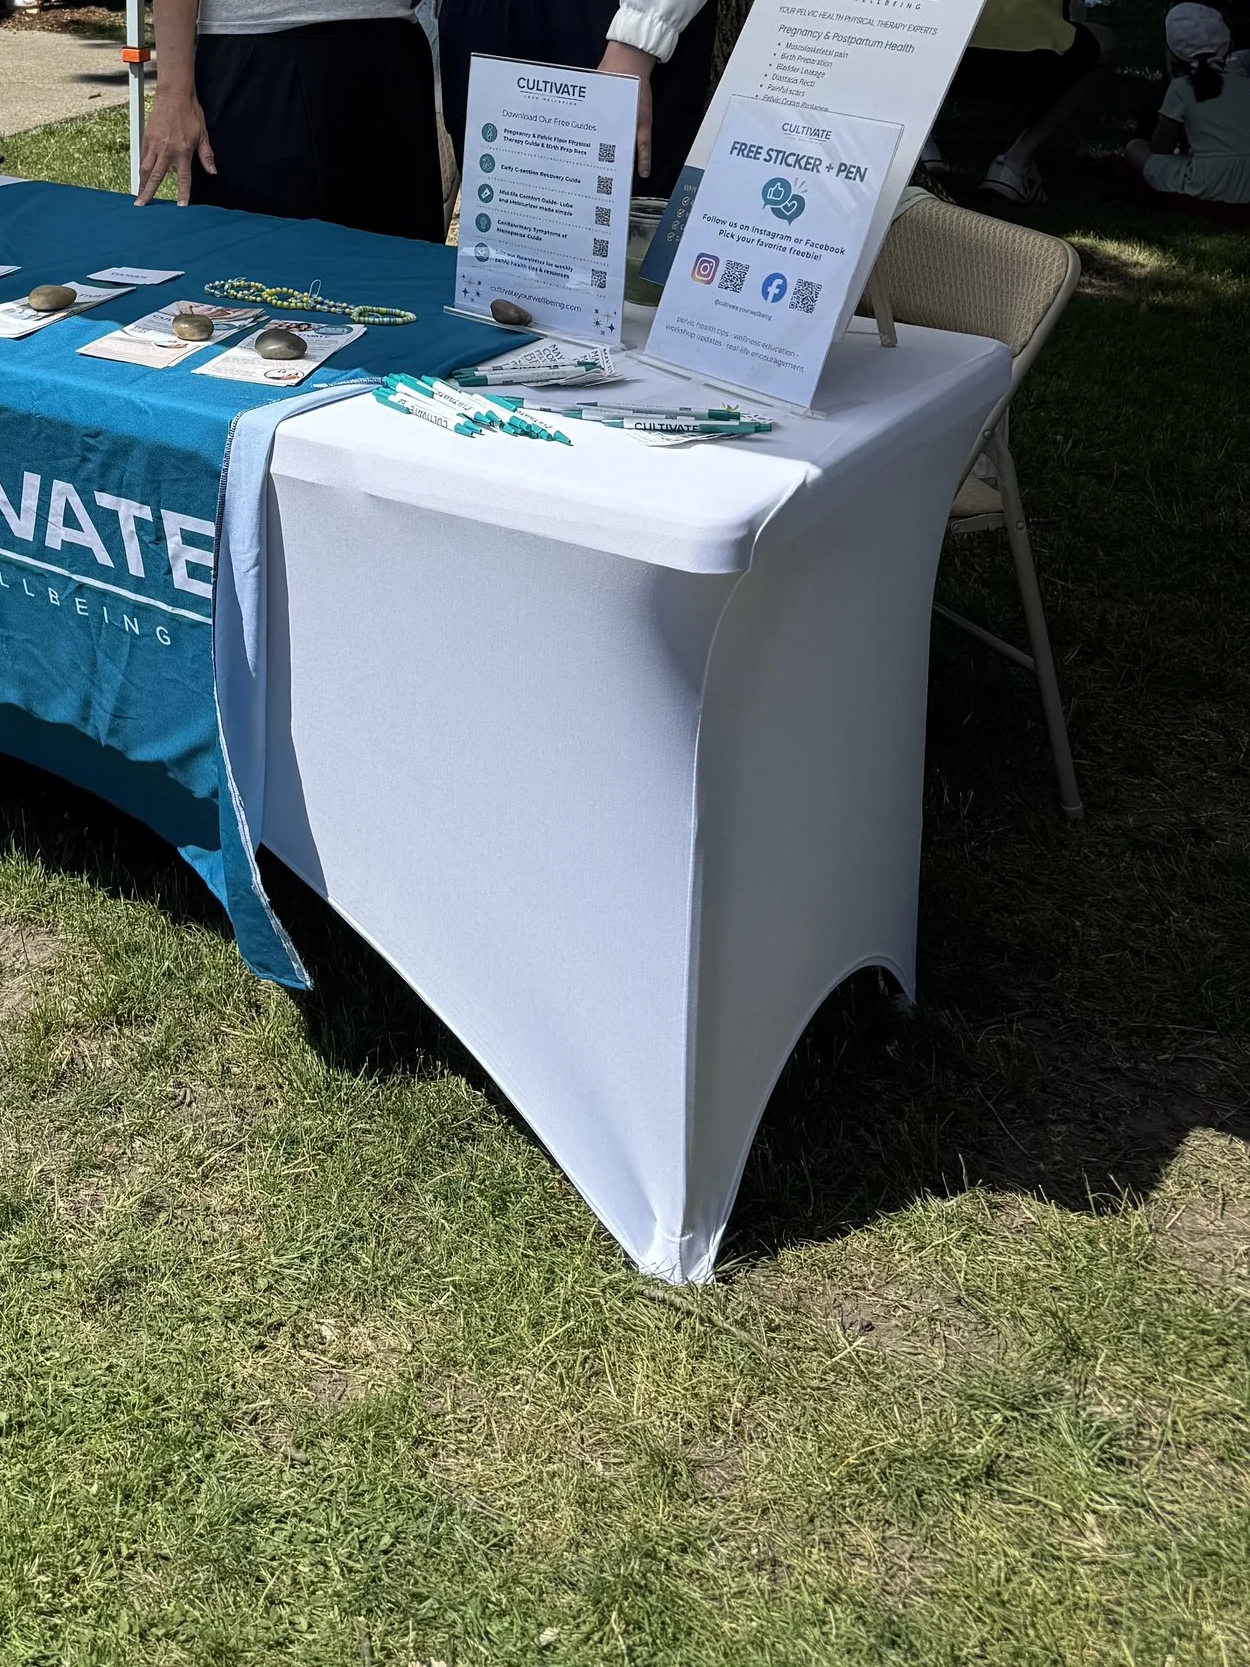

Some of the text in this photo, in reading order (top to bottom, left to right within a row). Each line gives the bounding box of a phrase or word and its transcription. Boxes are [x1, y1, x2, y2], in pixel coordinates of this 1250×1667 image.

[779, 6, 938, 36] YOUR PELVIC HEALTH PHYSICAL THERAPY EXPERTS
[778, 24, 823, 42] Pregnancy
[832, 32, 883, 49] Postpartum
[885, 41, 915, 53] Health
[834, 50, 849, 59] pain
[517, 77, 586, 98] CULTIVATE
[503, 109, 597, 131] Download Our Free Guides
[782, 122, 832, 140] CULTIVATE
[730, 141, 868, 182] FREE STICKER + PEN
[702, 213, 727, 226] Follow
[740, 224, 750, 232] on
[752, 225, 792, 245] Instagram
[794, 237, 803, 245] or
[805, 238, 846, 256] Facebook
[718, 229, 735, 240] Pick
[736, 234, 755, 244] your
[756, 238, 787, 254] favorite
[696, 322, 716, 332] health
[734, 333, 760, 347] wellness
[762, 342, 795, 357] education
[697, 335, 721, 347] updates
[751, 351, 804, 373] encouragement
[409, 405, 448, 428] CULTIVATE
[634, 422, 699, 432] CULTIVATE
